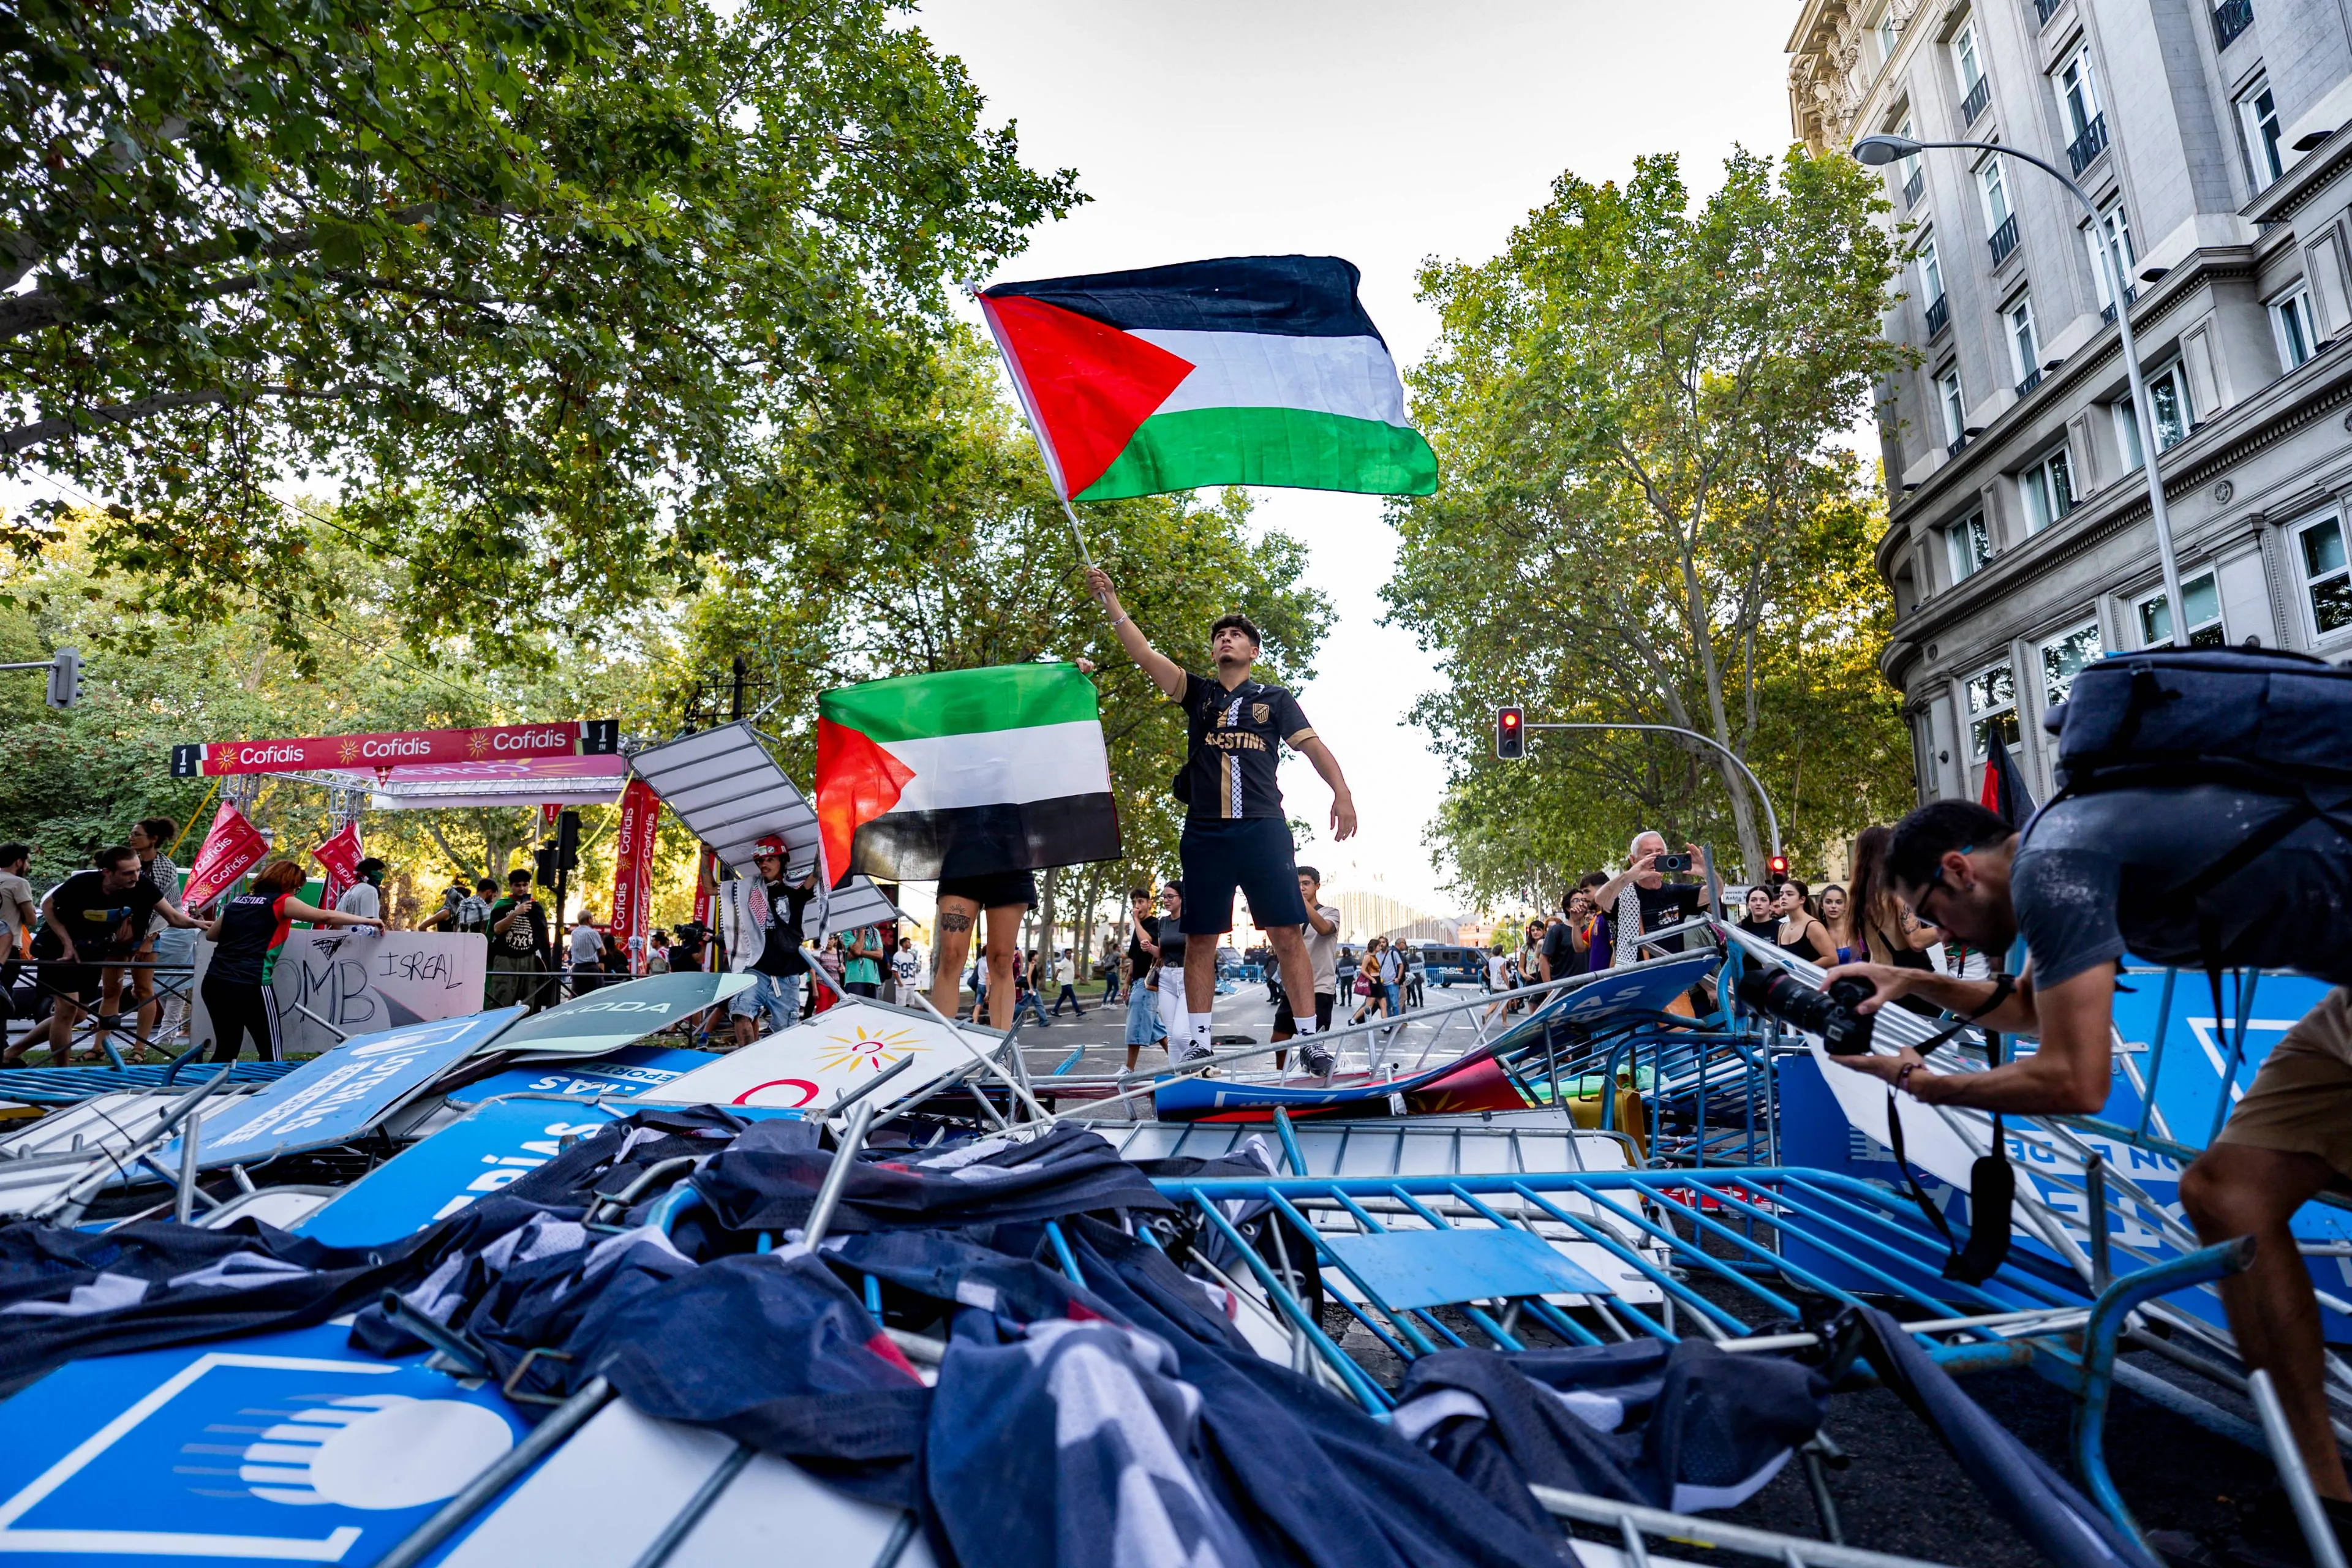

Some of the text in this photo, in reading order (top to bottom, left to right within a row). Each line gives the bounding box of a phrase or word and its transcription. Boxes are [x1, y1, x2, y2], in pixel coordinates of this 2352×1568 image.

[493, 729, 567, 752] Cofidis
[598, 724, 607, 742] 1
[1205, 731, 1267, 752] ALESTINE
[179, 748, 187, 766] 1
[240, 745, 304, 765] Cofidis
[363, 737, 431, 758] Cofidis
[620, 807, 634, 854] Cofidis
[643, 813, 655, 858] Cofidis
[195, 837, 232, 872] Cofidis
[211, 854, 249, 884] Cofidis
[614, 882, 627, 930] Cofidis
[695, 897, 704, 921] fidis
[378, 951, 463, 990] ISREAL
[272, 958, 375, 1025] OMB
[584, 1064, 673, 1082] EPORTE
